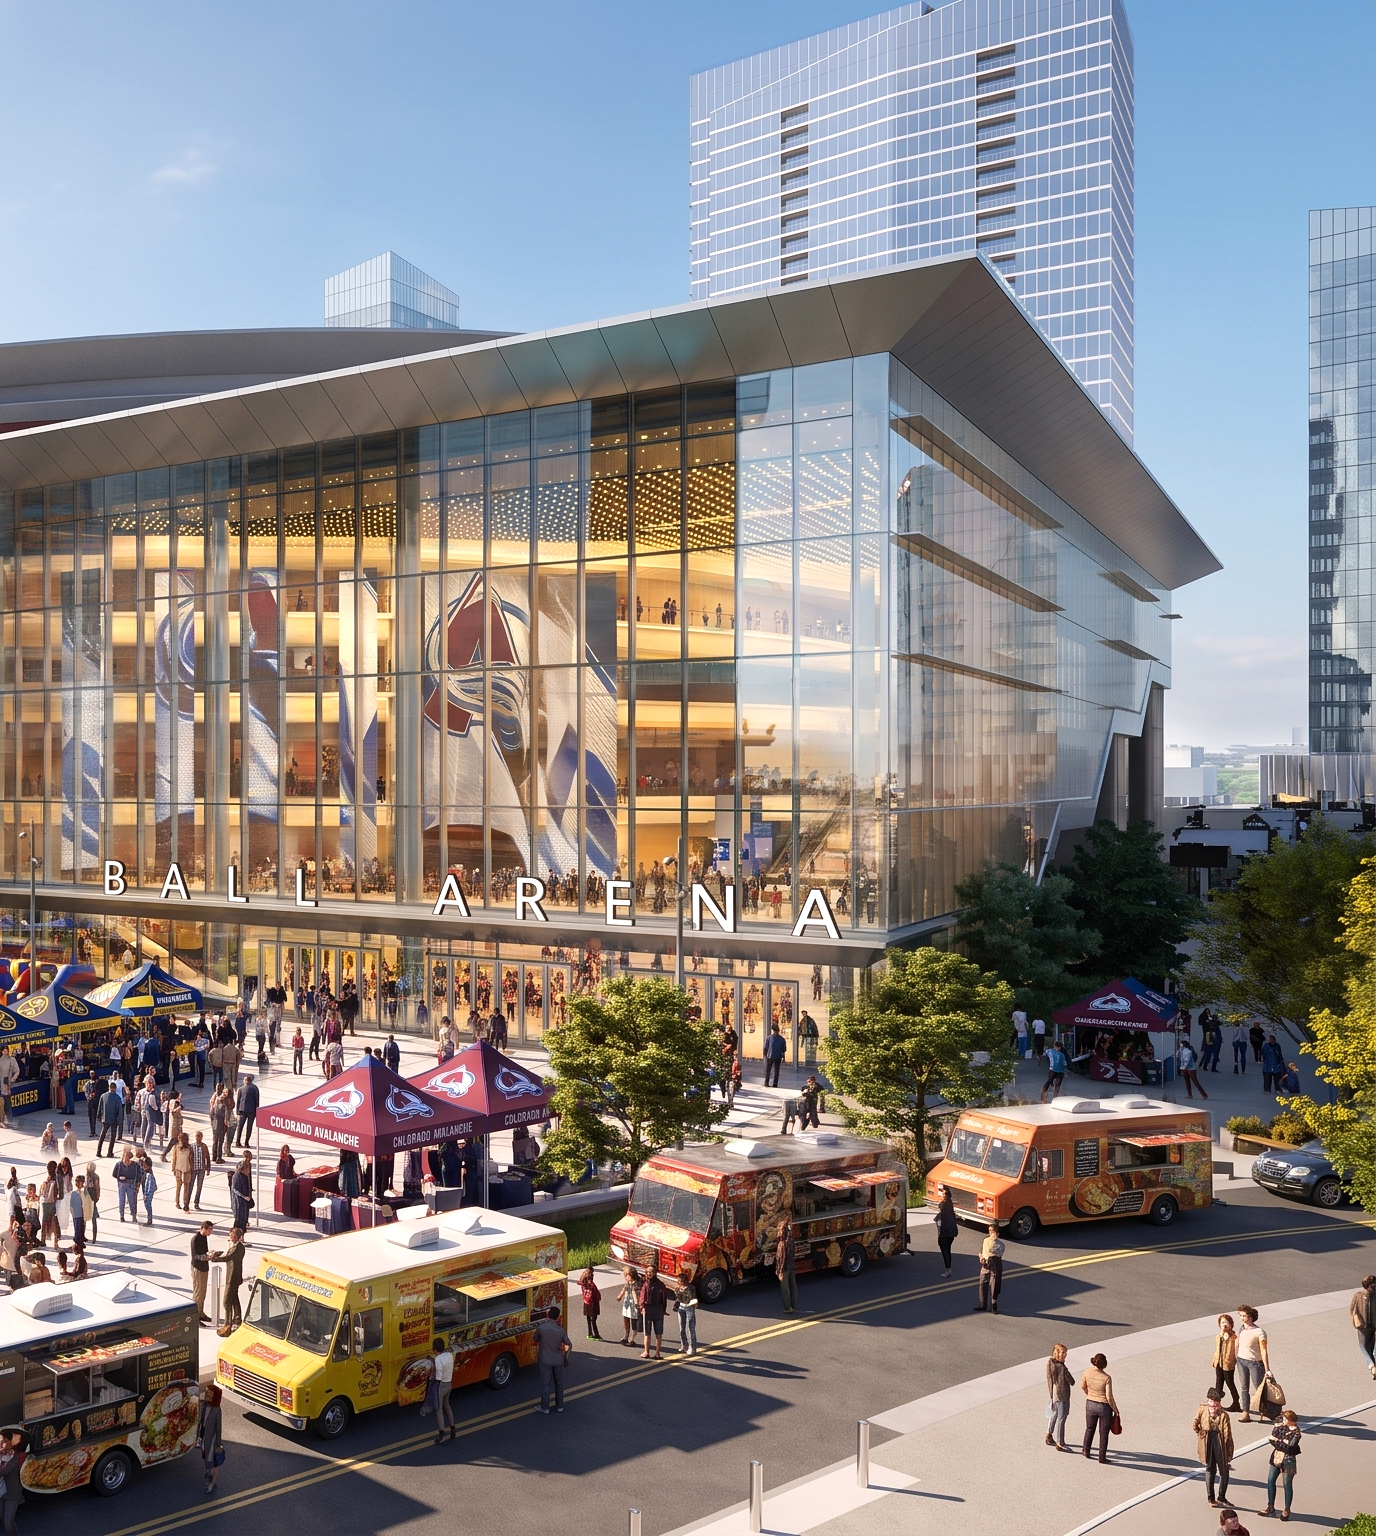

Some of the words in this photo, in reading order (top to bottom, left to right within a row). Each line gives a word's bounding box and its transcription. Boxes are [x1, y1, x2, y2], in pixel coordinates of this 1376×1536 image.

[103, 860, 319, 908] BALL
[432, 873, 843, 940] ARENA
[270, 1115, 312, 1136] COLORADO
[314, 1126, 360, 1148] AVALANCHE
